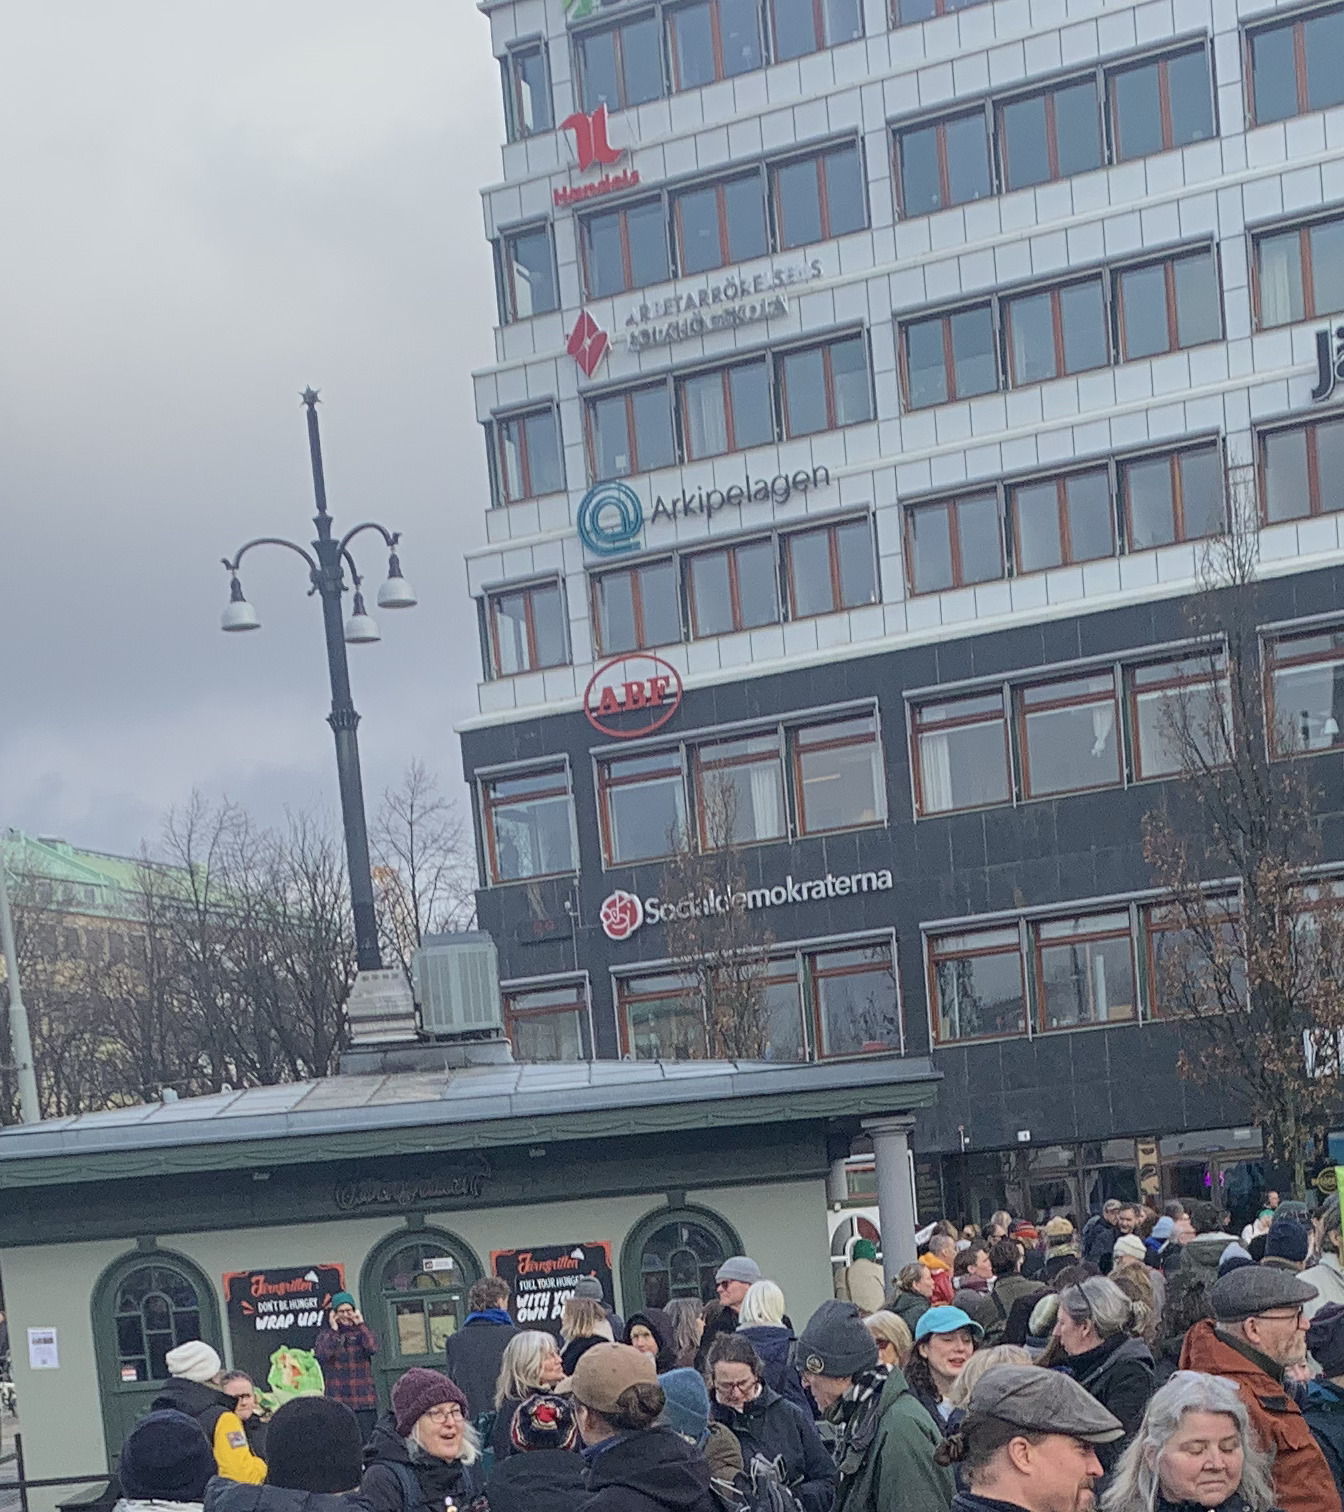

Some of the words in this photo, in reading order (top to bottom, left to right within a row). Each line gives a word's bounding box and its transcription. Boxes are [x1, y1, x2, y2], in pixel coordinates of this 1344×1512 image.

[651, 463, 830, 524] Arkipelagen
[597, 674, 671, 717] ABF
[644, 869, 893, 924] Socialdemokraterna
[537, 1277, 556, 1289] YOUR
[279, 1299, 289, 1311] BE
[516, 1291, 551, 1309] WITH
[553, 1289, 576, 1306] YO
[255, 1312, 295, 1331] WRAP
[297, 1309, 325, 1327] UP!
[517, 1306, 549, 1323] OWN
